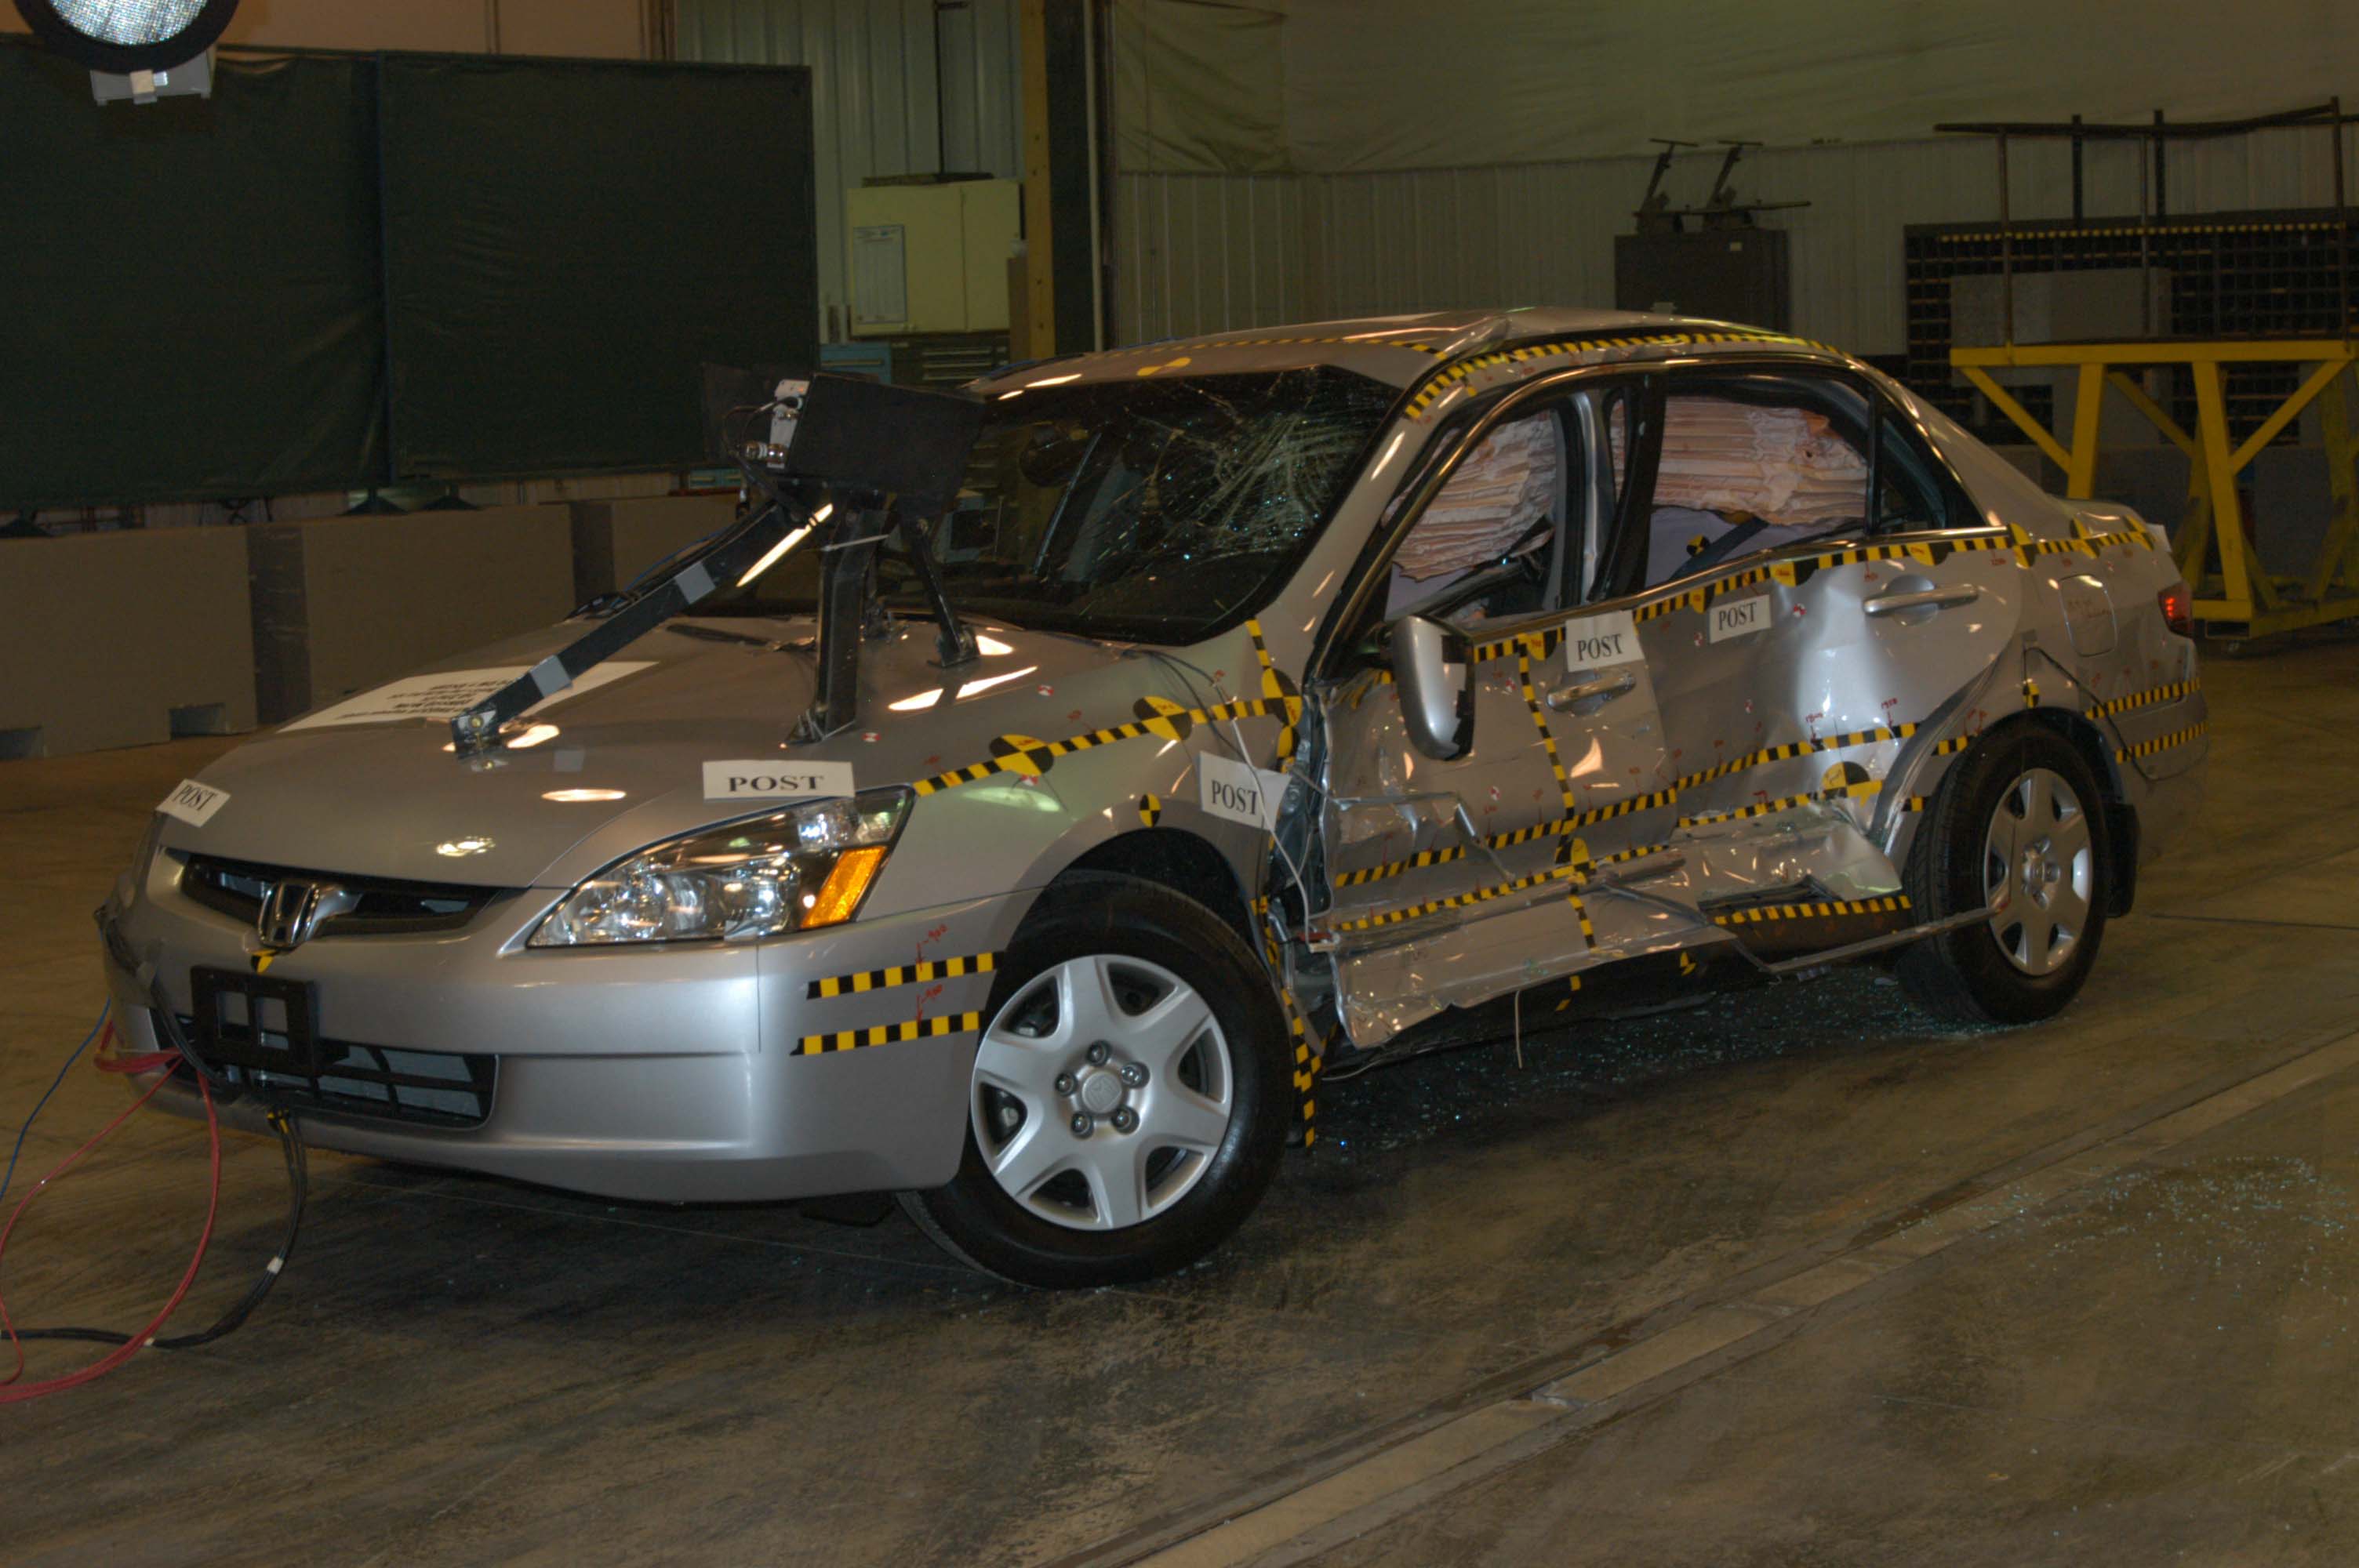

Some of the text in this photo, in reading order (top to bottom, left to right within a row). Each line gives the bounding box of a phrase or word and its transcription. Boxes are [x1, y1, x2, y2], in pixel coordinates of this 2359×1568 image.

[1718, 601, 1757, 630] POST
[1577, 633, 1623, 661] POST
[728, 775, 825, 792] POST
[1211, 779, 1259, 815] POST
[171, 785, 219, 811] POST
